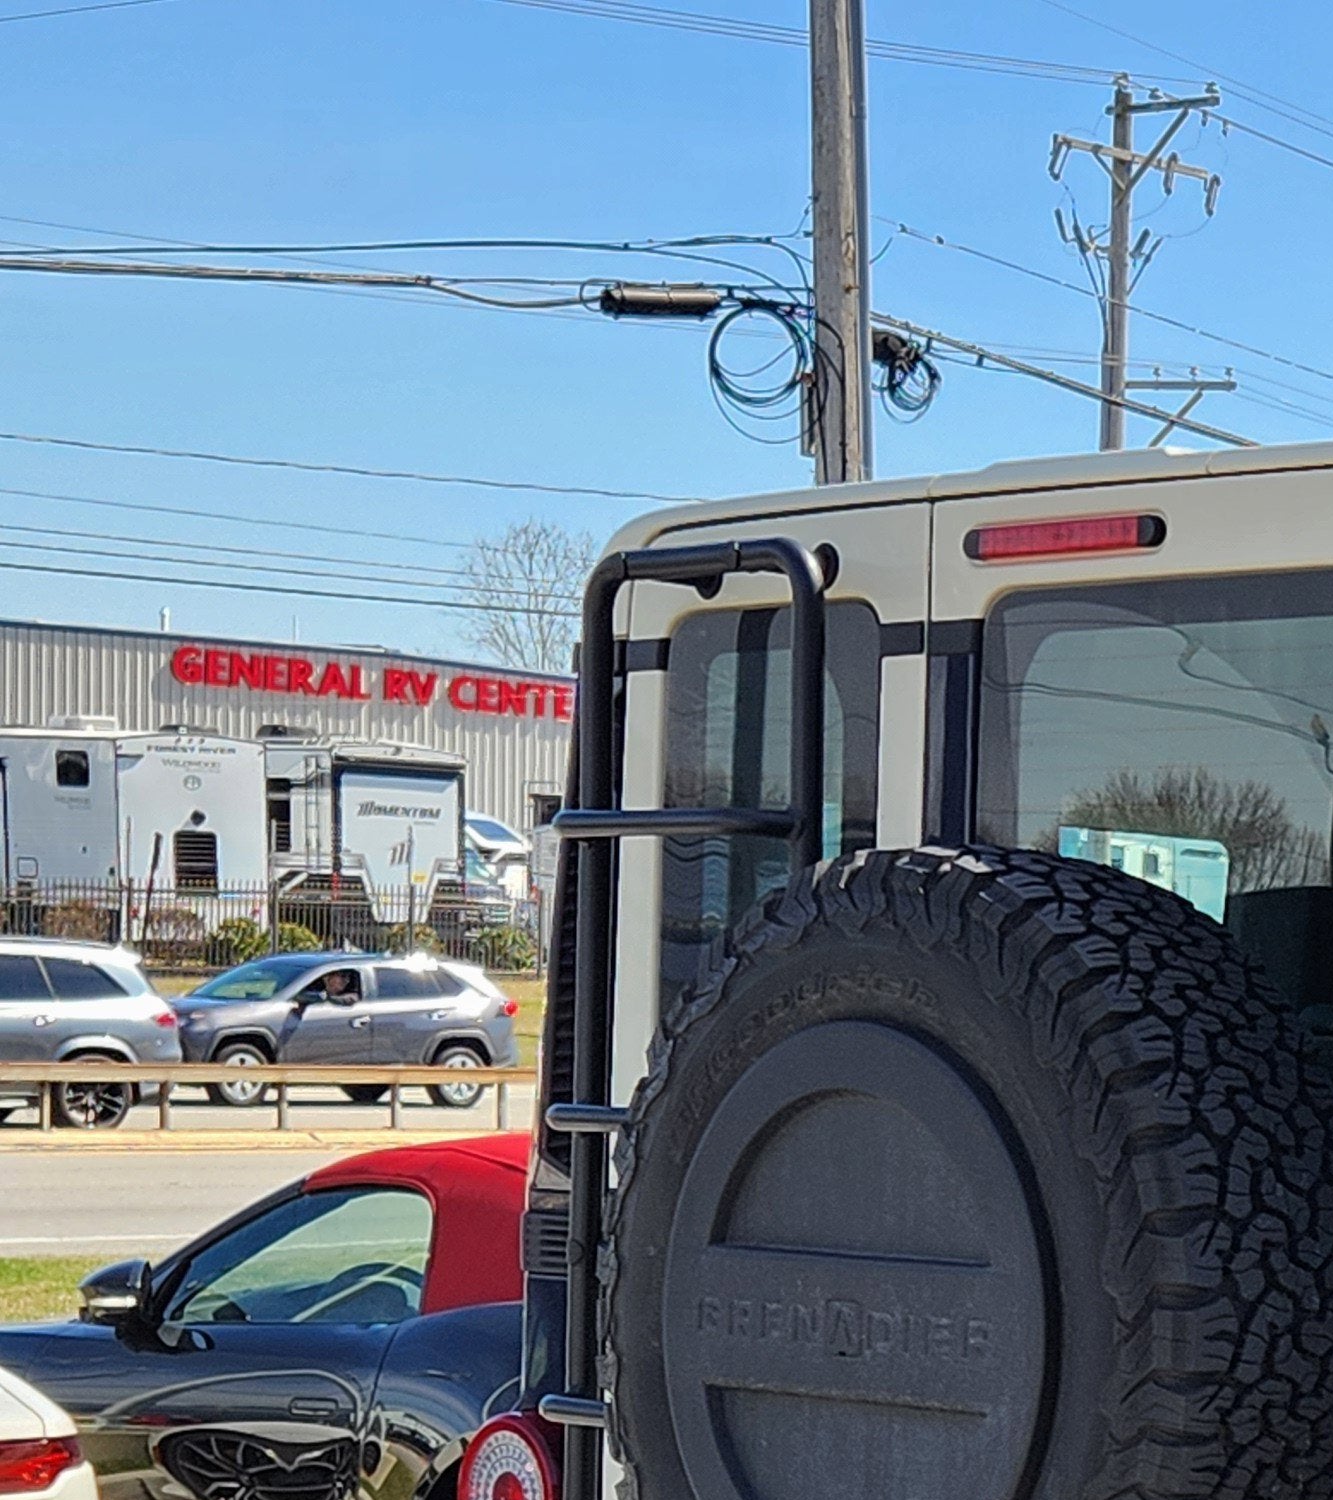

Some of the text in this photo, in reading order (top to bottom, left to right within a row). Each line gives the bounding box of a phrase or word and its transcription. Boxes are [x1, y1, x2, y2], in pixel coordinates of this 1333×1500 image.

[171, 645, 575, 724] GENERAL RV CENTE
